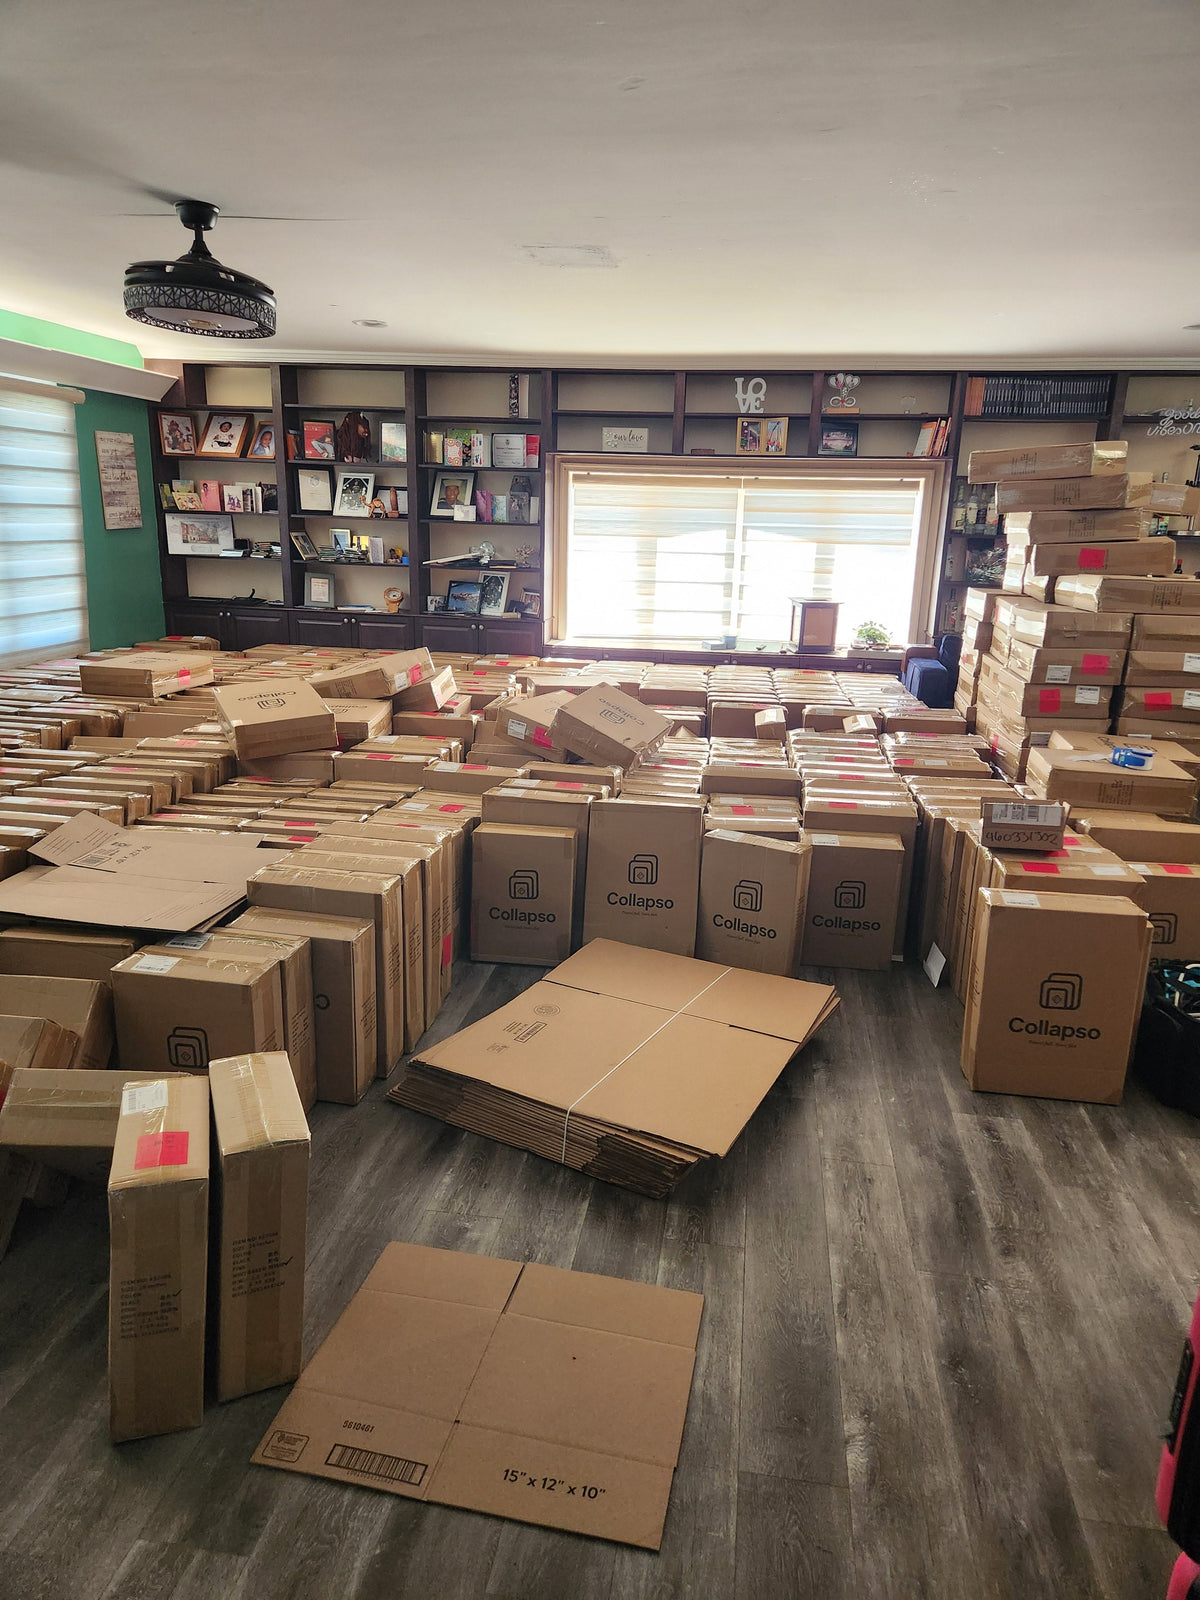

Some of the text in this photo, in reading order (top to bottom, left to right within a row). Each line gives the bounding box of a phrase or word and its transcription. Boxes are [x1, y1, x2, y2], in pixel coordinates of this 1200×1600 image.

[606, 891, 675, 911] Collapso
[488, 906, 557, 925] Collapso
[712, 914, 778, 939] Collapso
[811, 914, 882, 933] Collapso
[1008, 1016, 1101, 1041] Collapso
[503, 1468, 606, 1499] 15" x 12" x 10"
